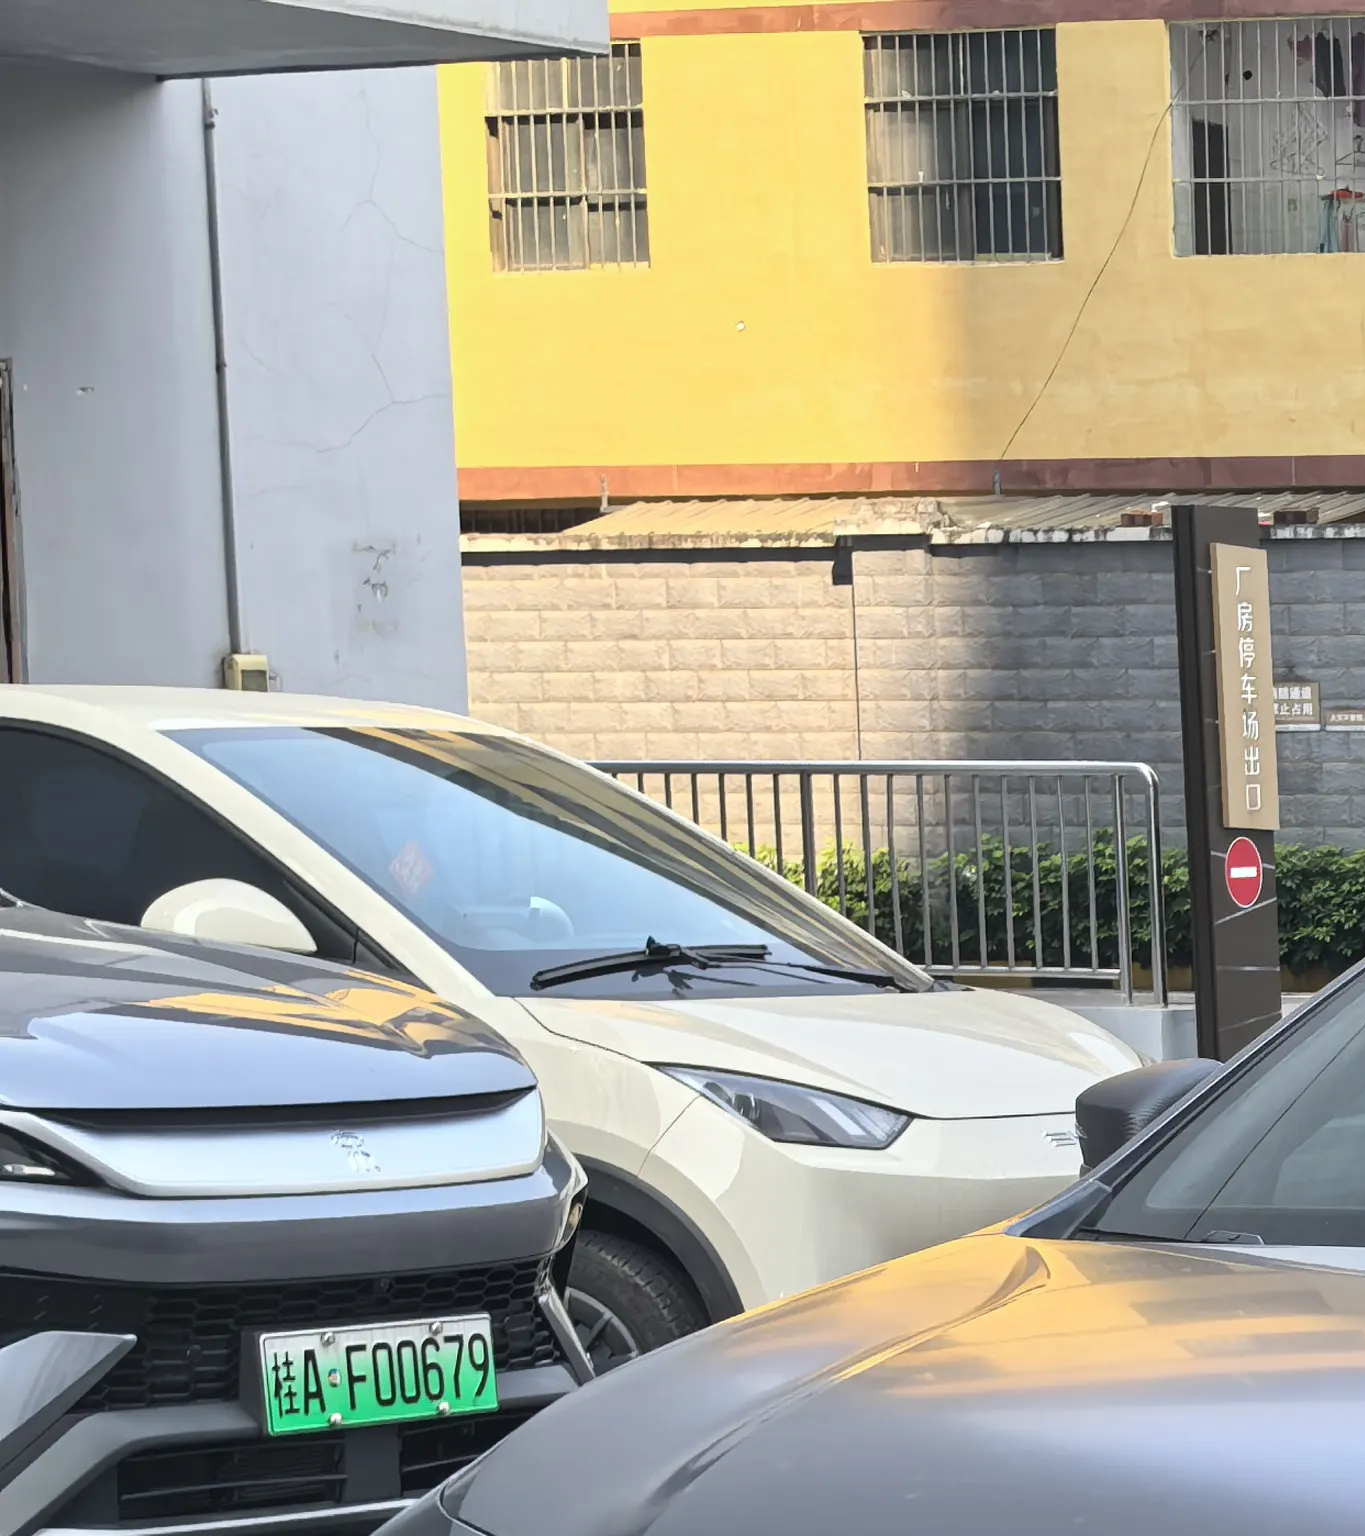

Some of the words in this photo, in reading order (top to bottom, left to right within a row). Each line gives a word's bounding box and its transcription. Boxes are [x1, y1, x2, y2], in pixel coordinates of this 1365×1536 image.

[1235, 566, 1262, 812] 厂房停车场出口
